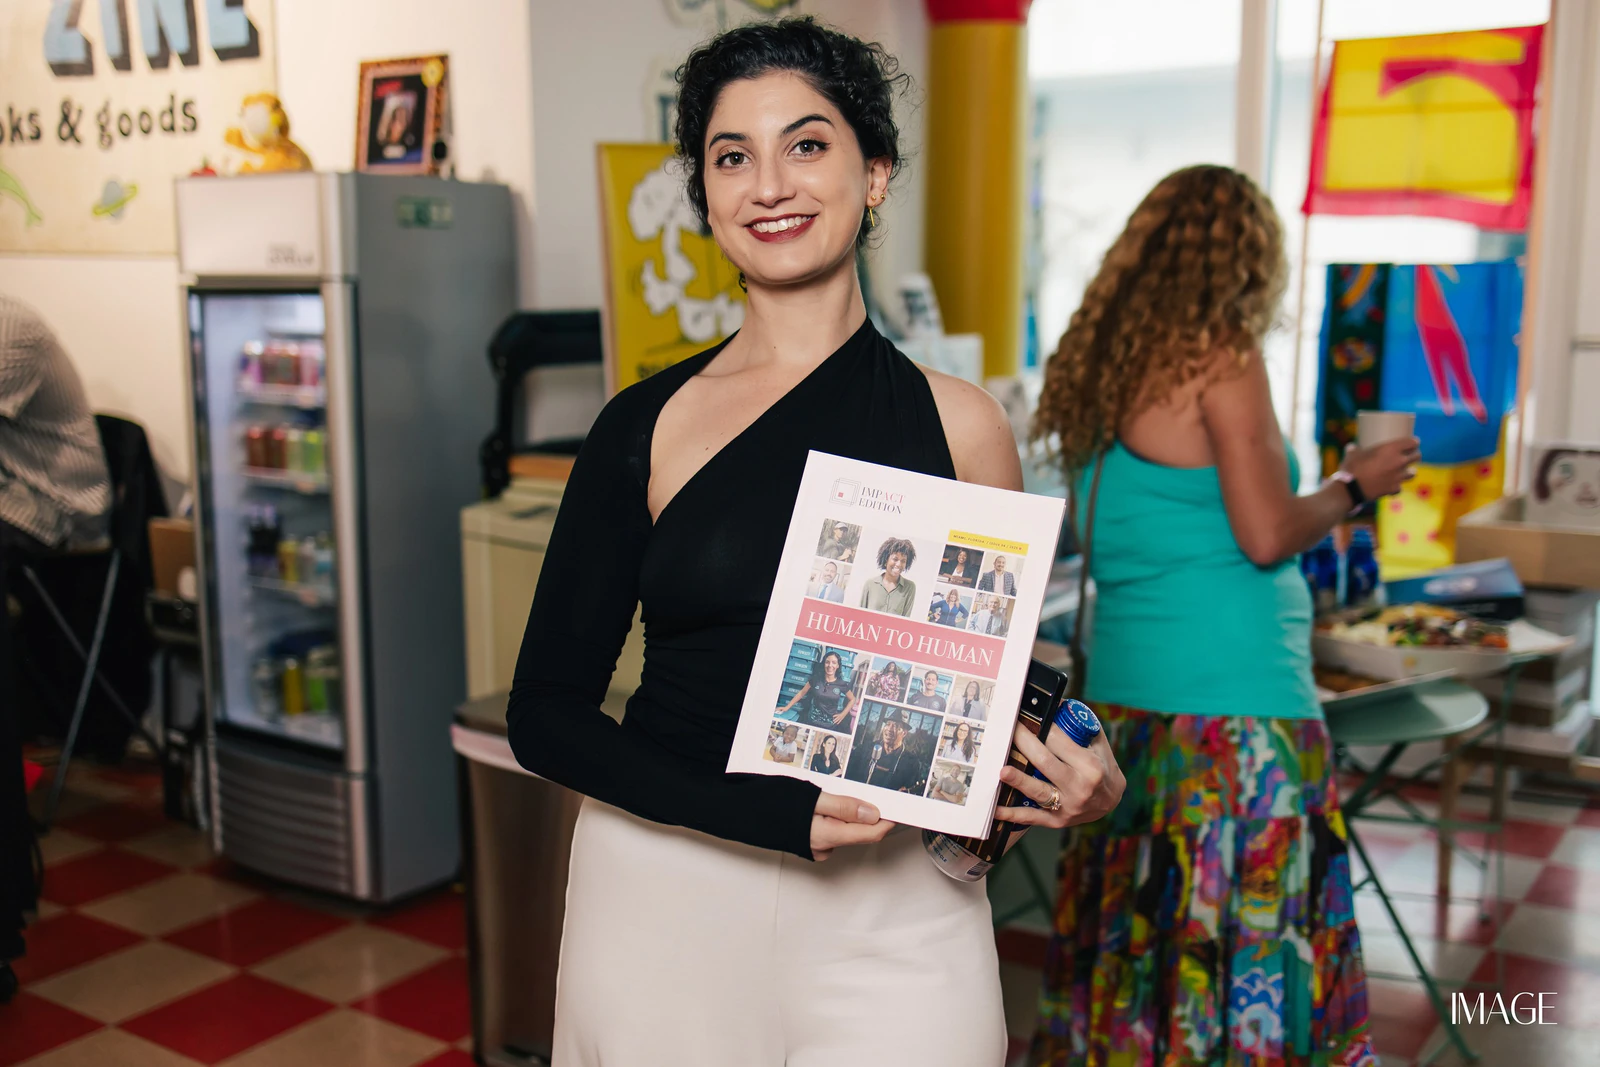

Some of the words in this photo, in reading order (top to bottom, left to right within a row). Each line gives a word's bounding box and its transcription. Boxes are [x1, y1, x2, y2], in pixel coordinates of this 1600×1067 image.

[57, 98, 83, 144] &
[97, 92, 199, 150] goods
[858, 497, 902, 515] EDITION
[861, 486, 905, 504] IMPACT
[805, 611, 883, 643] HUMAN
[885, 627, 914, 650] TO
[917, 632, 995, 667] HUMAN
